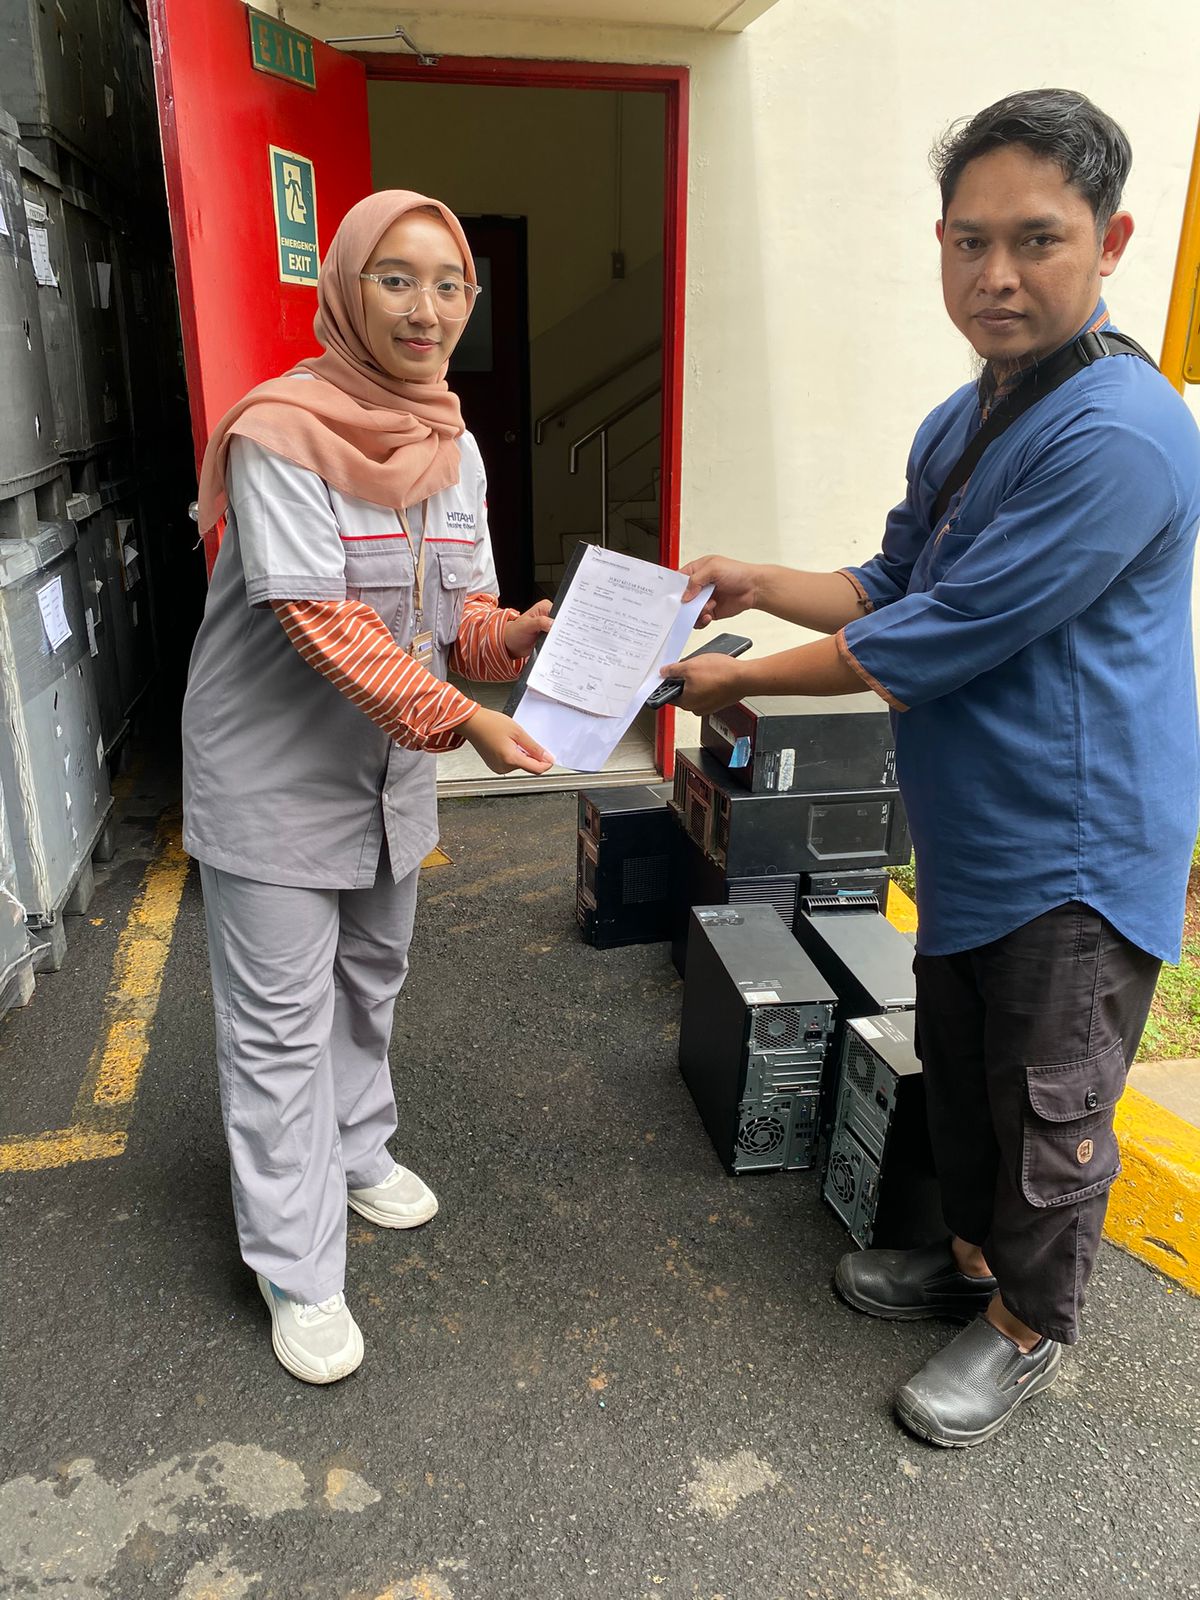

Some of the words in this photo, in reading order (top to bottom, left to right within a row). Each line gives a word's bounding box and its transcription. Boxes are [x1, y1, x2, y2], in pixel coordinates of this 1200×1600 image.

[257, 23, 307, 77] EXIT
[280, 236, 317, 253] EMERGENCY
[288, 253, 312, 273] EXIT
